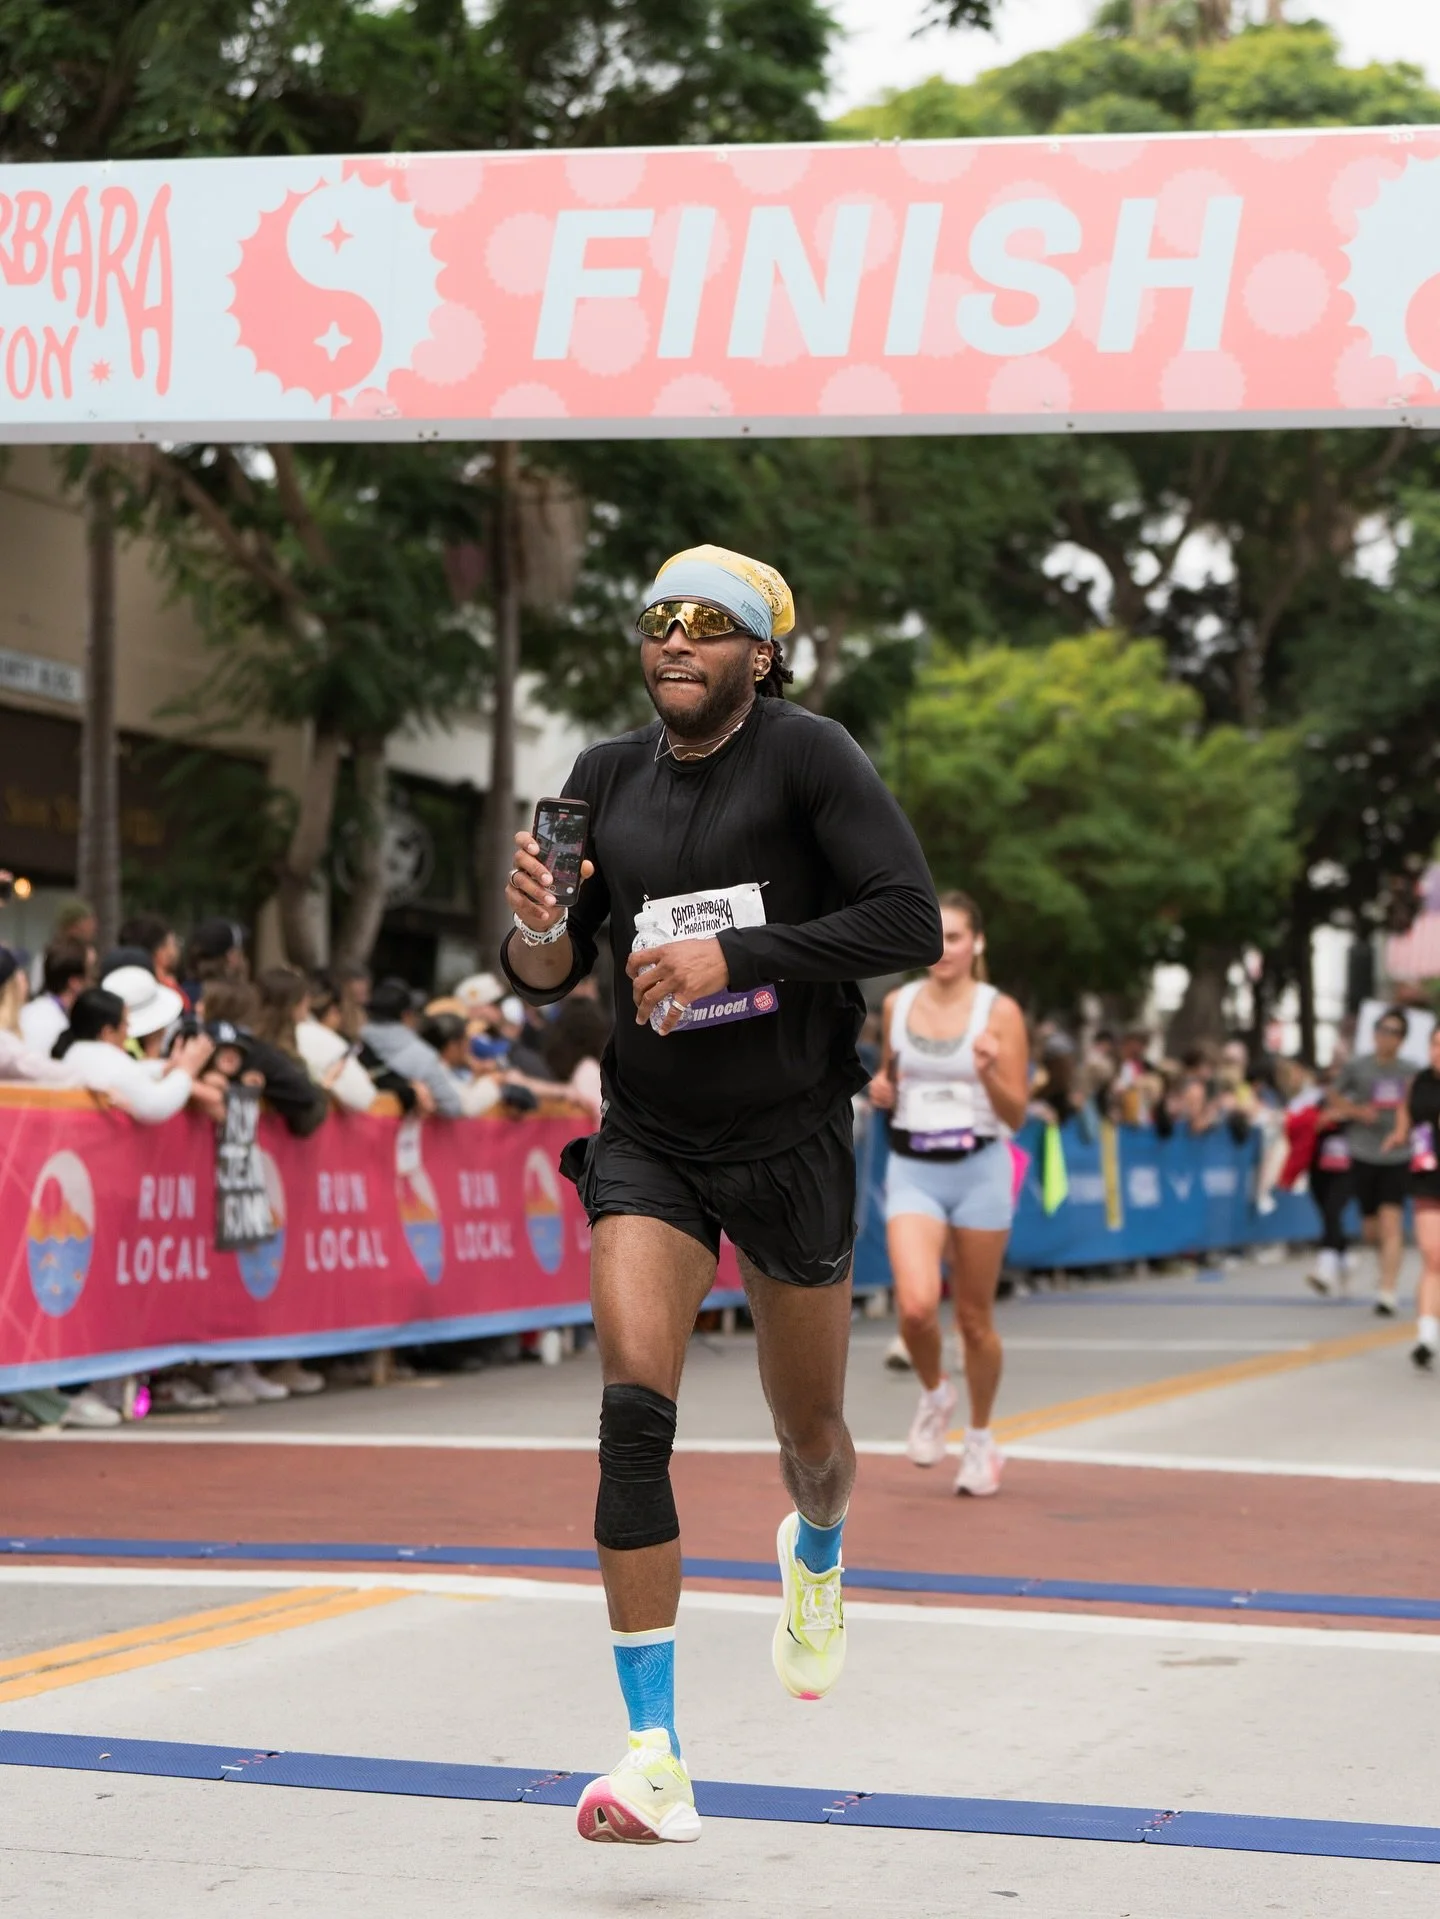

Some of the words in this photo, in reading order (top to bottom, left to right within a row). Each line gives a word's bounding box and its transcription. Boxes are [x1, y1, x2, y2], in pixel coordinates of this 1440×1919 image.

[532, 195, 1244, 361] FINISH
[0, 325, 79, 400] ON
[671, 904, 696, 936] SANTA
[696, 897, 735, 927] BARBARA
[684, 918, 721, 935] MARATHON
[138, 1174, 196, 1221] RUN
[317, 1171, 367, 1214] RUN
[458, 1171, 498, 1209] RUN
[116, 1235, 210, 1285] LOCAL
[305, 1227, 388, 1273] LOCAL
[453, 1222, 514, 1261] LOCAL
